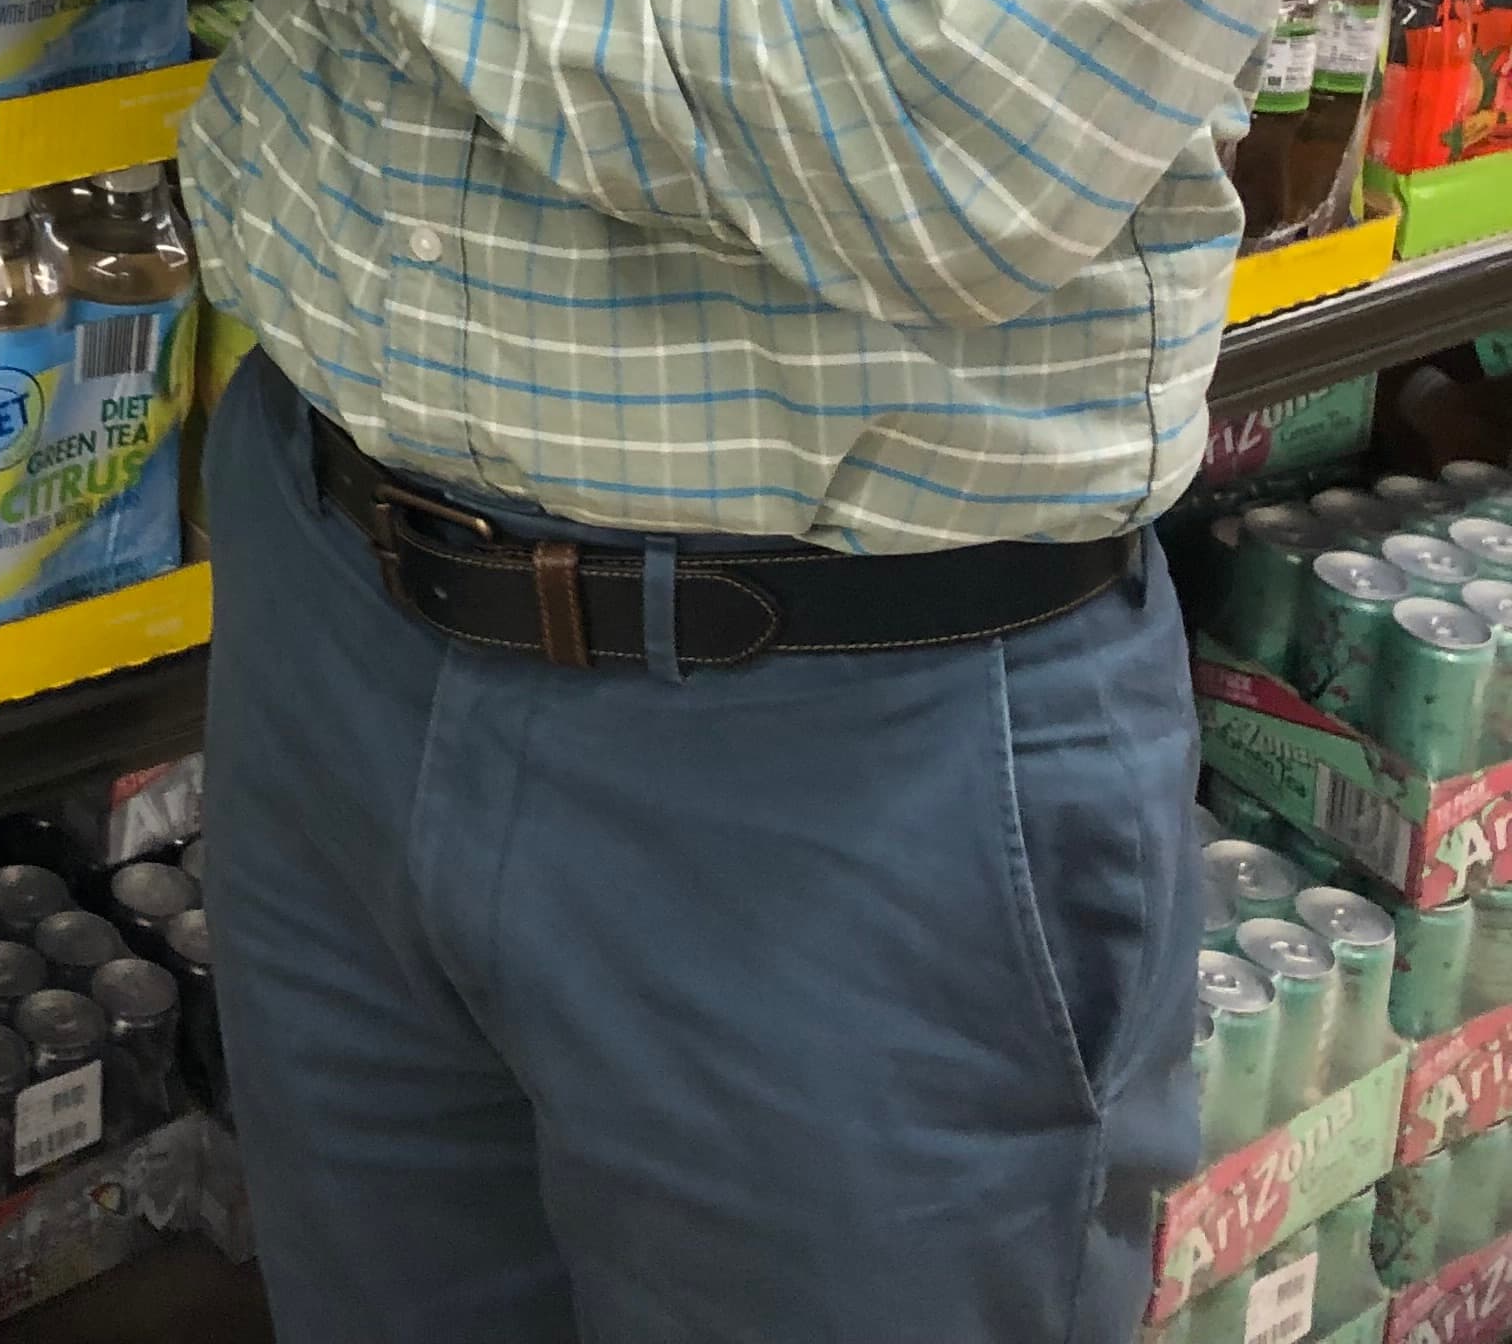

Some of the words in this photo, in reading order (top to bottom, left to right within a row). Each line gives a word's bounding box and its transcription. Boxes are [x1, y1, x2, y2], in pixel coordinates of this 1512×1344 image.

[102, 395, 154, 422] DIET
[27, 433, 96, 475] GREEN
[107, 423, 148, 448] TEA
[0, 450, 145, 524] CITRUS
[1166, 1094, 1356, 1280] AriZona
